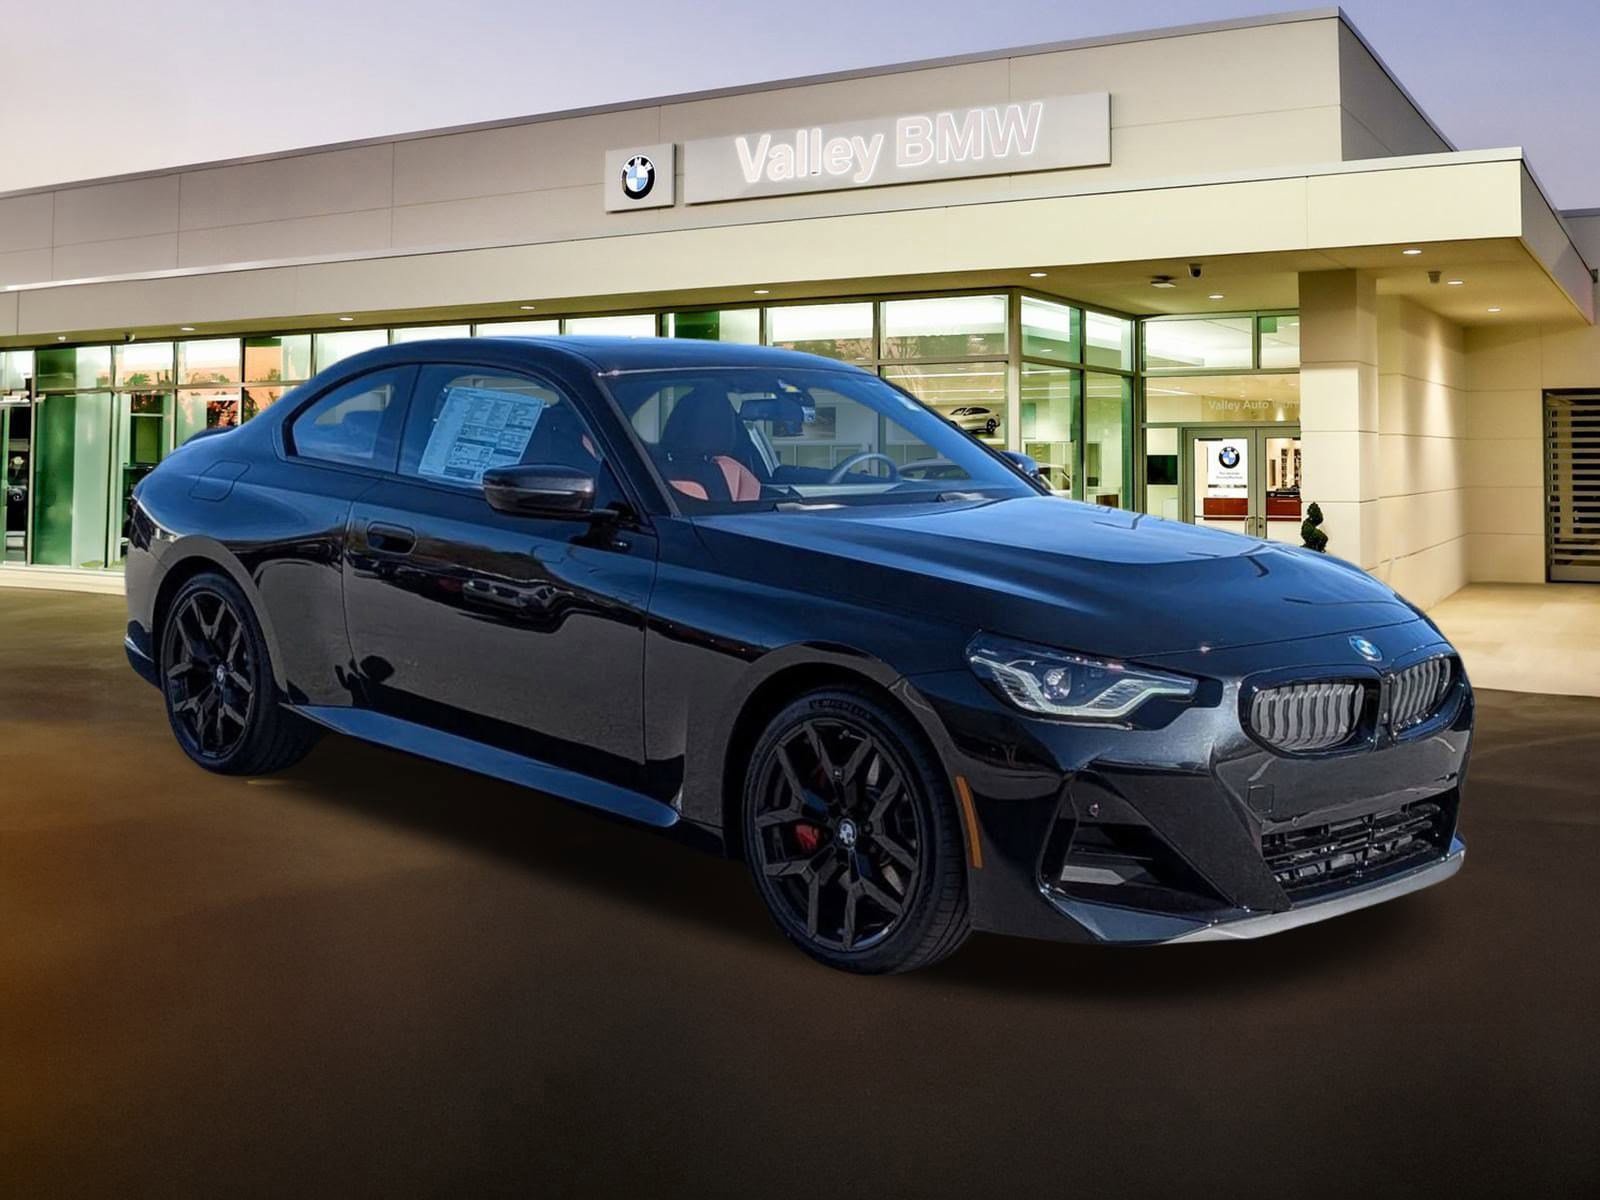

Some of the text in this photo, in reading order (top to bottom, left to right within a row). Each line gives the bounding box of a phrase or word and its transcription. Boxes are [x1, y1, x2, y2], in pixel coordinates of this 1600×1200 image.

[735, 102, 1043, 183] Valley BMW
[1208, 400, 1241, 411] Valley
[1243, 400, 1269, 409] Auto
